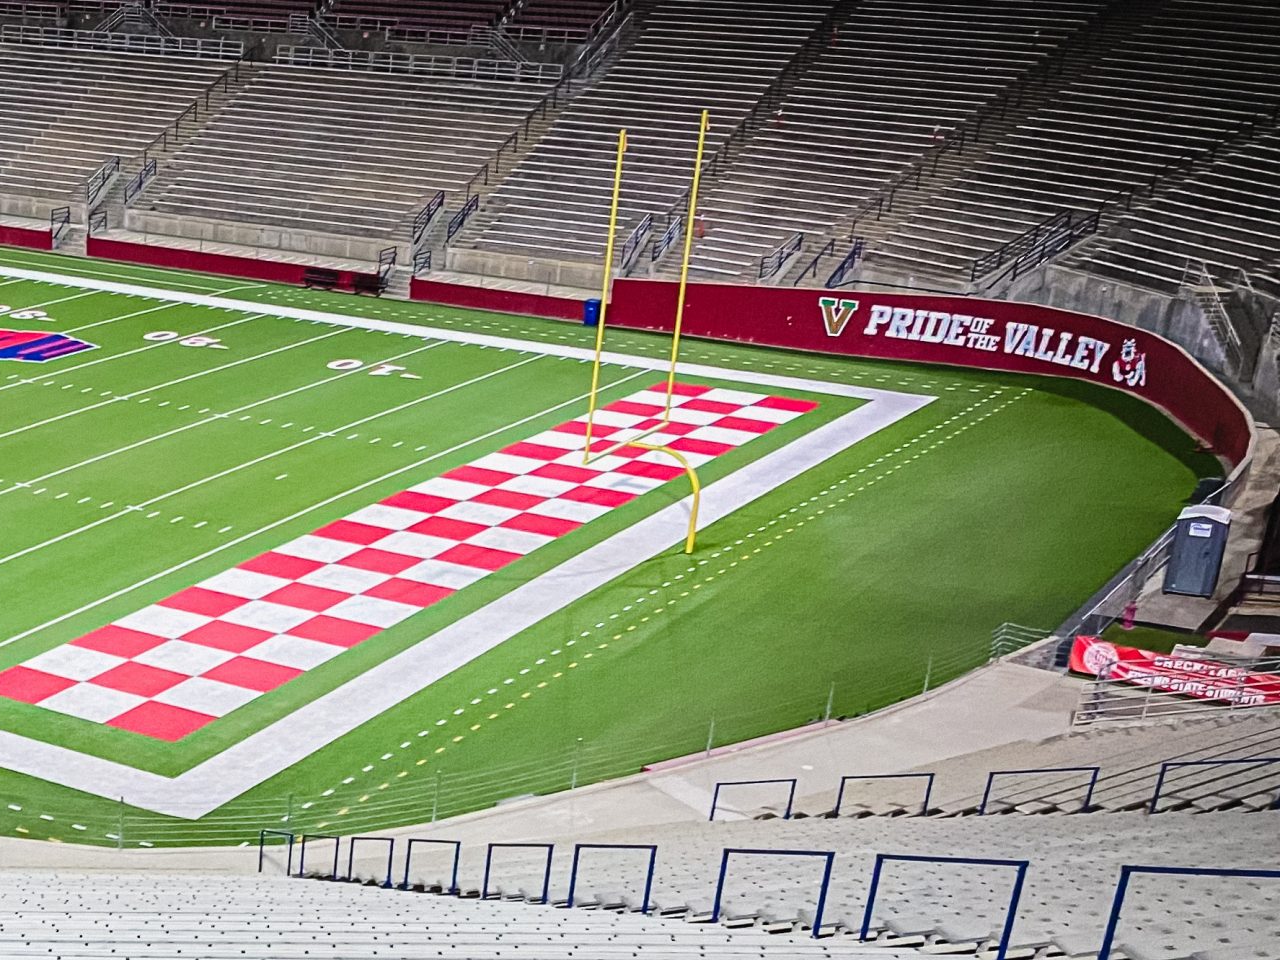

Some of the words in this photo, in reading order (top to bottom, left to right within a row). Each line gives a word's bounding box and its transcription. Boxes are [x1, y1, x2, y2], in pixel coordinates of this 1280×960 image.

[864, 304, 974, 346] PRIDE
[972, 316, 996, 335] OF
[143, 331, 221, 348] 20
[967, 332, 1000, 352] THE
[1004, 321, 1111, 374] VALLEY
[326, 359, 406, 376] 10
